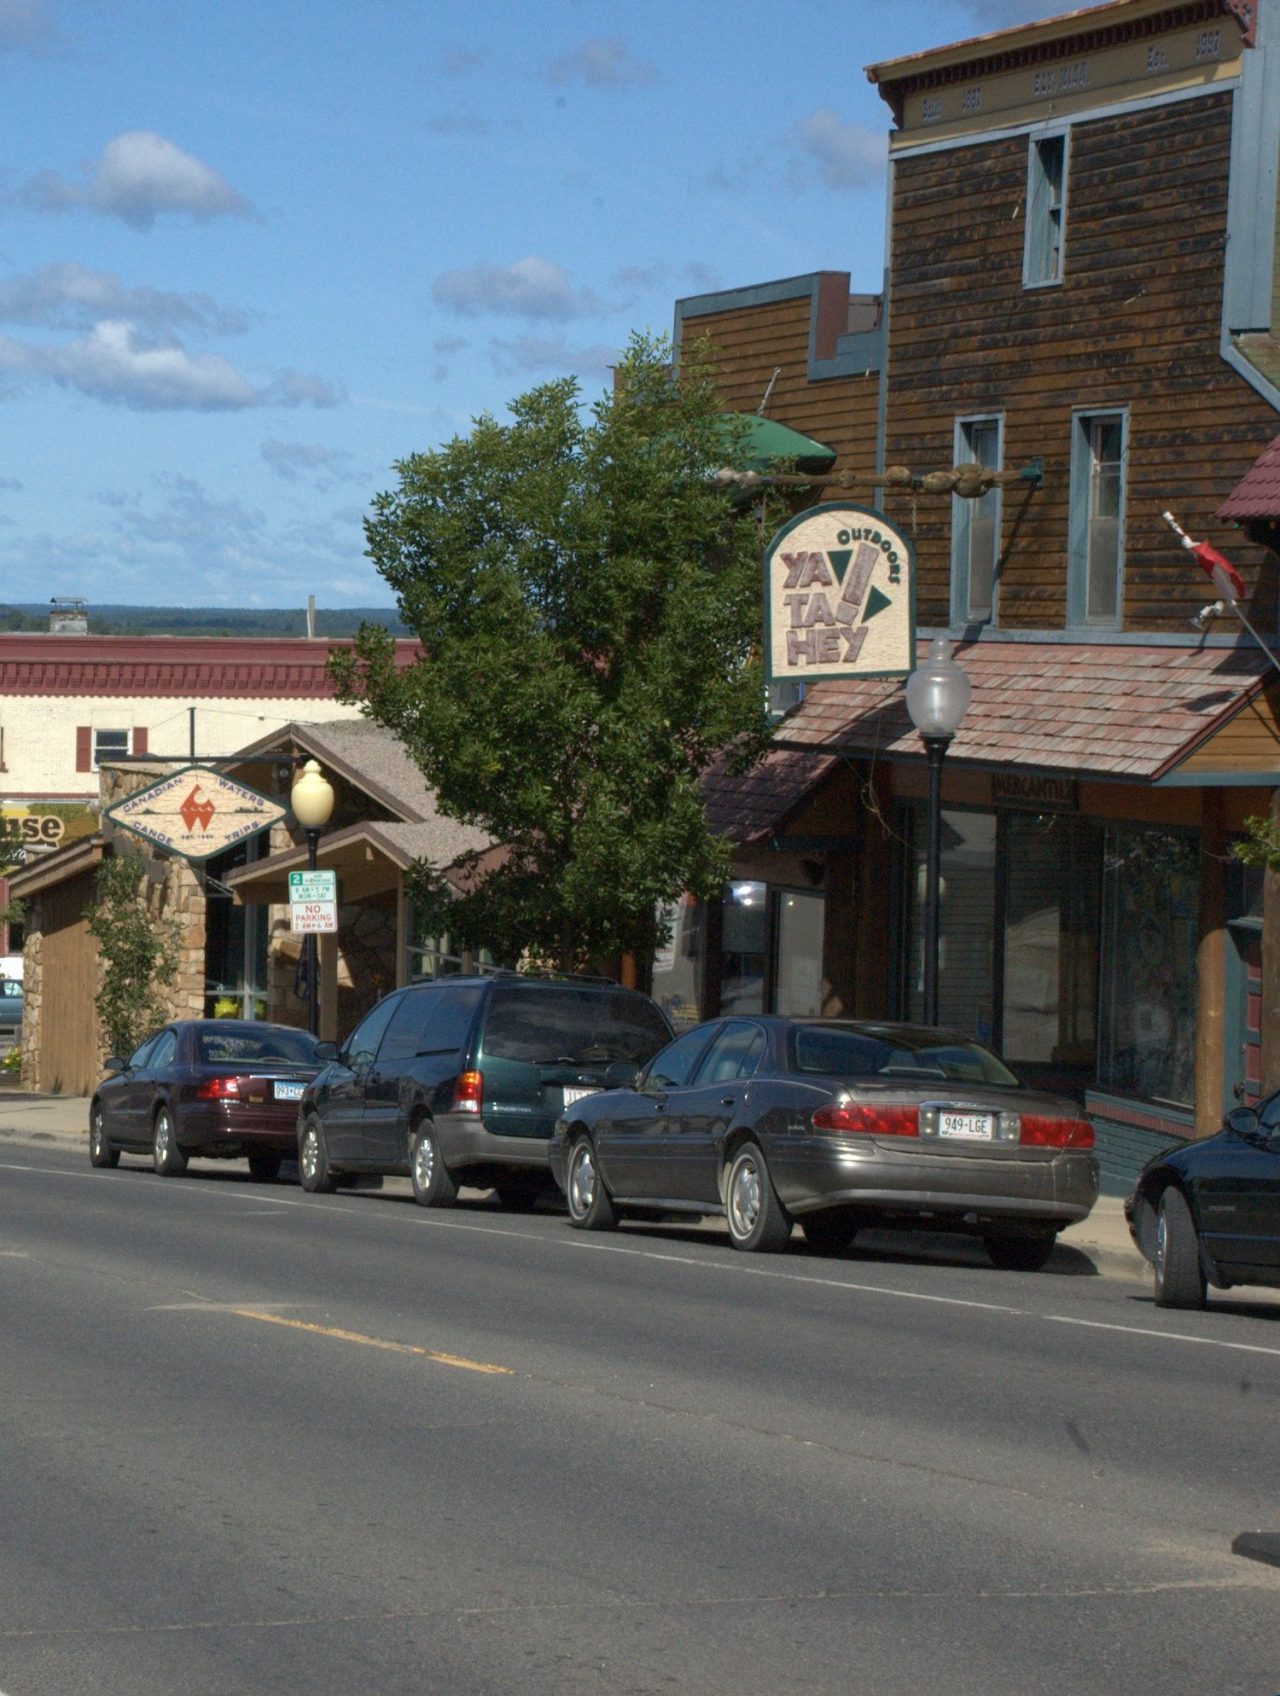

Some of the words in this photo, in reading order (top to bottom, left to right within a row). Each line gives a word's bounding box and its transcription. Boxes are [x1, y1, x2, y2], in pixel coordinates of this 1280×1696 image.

[780, 550, 833, 588] YA
[836, 527, 901, 585] OUTDOORS
[782, 592, 837, 628] TA
[785, 625, 869, 665] HEY
[122, 776, 183, 813] CANADIAN
[218, 778, 265, 807] WATERS
[133, 821, 174, 845] CANOE
[225, 821, 260, 842] TRIPS
[293, 874, 301, 884] 2
[295, 913, 332, 922] PARKING
[305, 904, 321, 913] NO
[944, 1117, 988, 1134] 949-LGE
